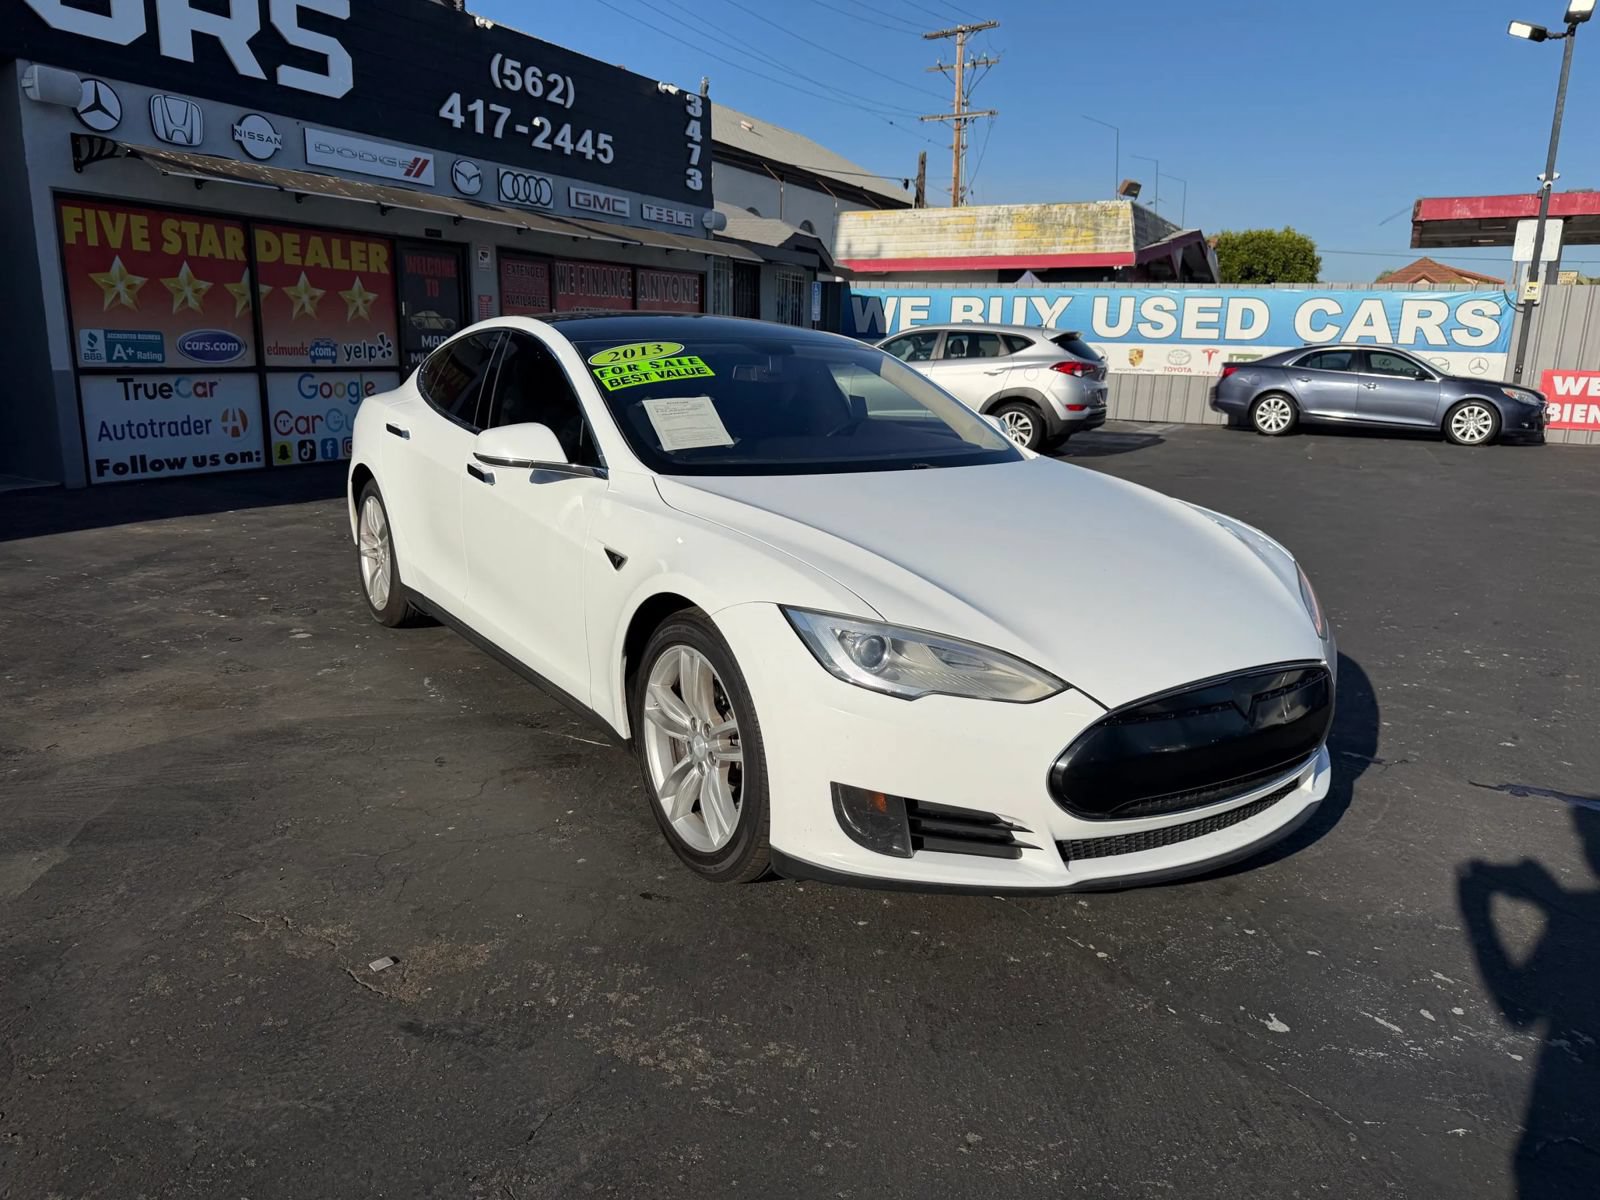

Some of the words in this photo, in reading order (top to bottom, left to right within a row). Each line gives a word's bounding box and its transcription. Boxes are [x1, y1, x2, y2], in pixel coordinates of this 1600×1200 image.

[489, 52, 575, 109] (562)
[234, 128, 282, 146] NISSAN
[438, 91, 614, 164] 417-2445
[314, 143, 414, 168] DODGE
[575, 191, 626, 214] GMC
[644, 205, 692, 224] TESLA
[62, 205, 151, 252] FIVE
[161, 217, 247, 261] STAR
[254, 228, 390, 274] DEALER
[506, 263, 545, 279] EXTENDED
[425, 278, 439, 297] TO
[555, 262, 576, 295] WE
[578, 265, 633, 299] FINANCE
[639, 271, 699, 304] ANYONE
[505, 294, 546, 308] AVAILABLE
[851, 295, 930, 334] WE
[949, 295, 1073, 328] BUY
[1090, 295, 1271, 340] USED
[1293, 297, 1502, 346] CARS
[137, 351, 162, 362] Rating
[184, 341, 239, 352] cars.com
[343, 342, 377, 362] yelp
[607, 343, 664, 362] 2013
[598, 363, 639, 378] FOR
[649, 357, 699, 369] SALE
[607, 371, 651, 388] BEST
[655, 366, 707, 379] VALUE
[116, 376, 219, 401] TrueCar
[298, 373, 376, 405] Google
[98, 414, 213, 442] Autotrader
[95, 454, 187, 477] Follow
[192, 454, 221, 467] us
[225, 450, 261, 464] on:
